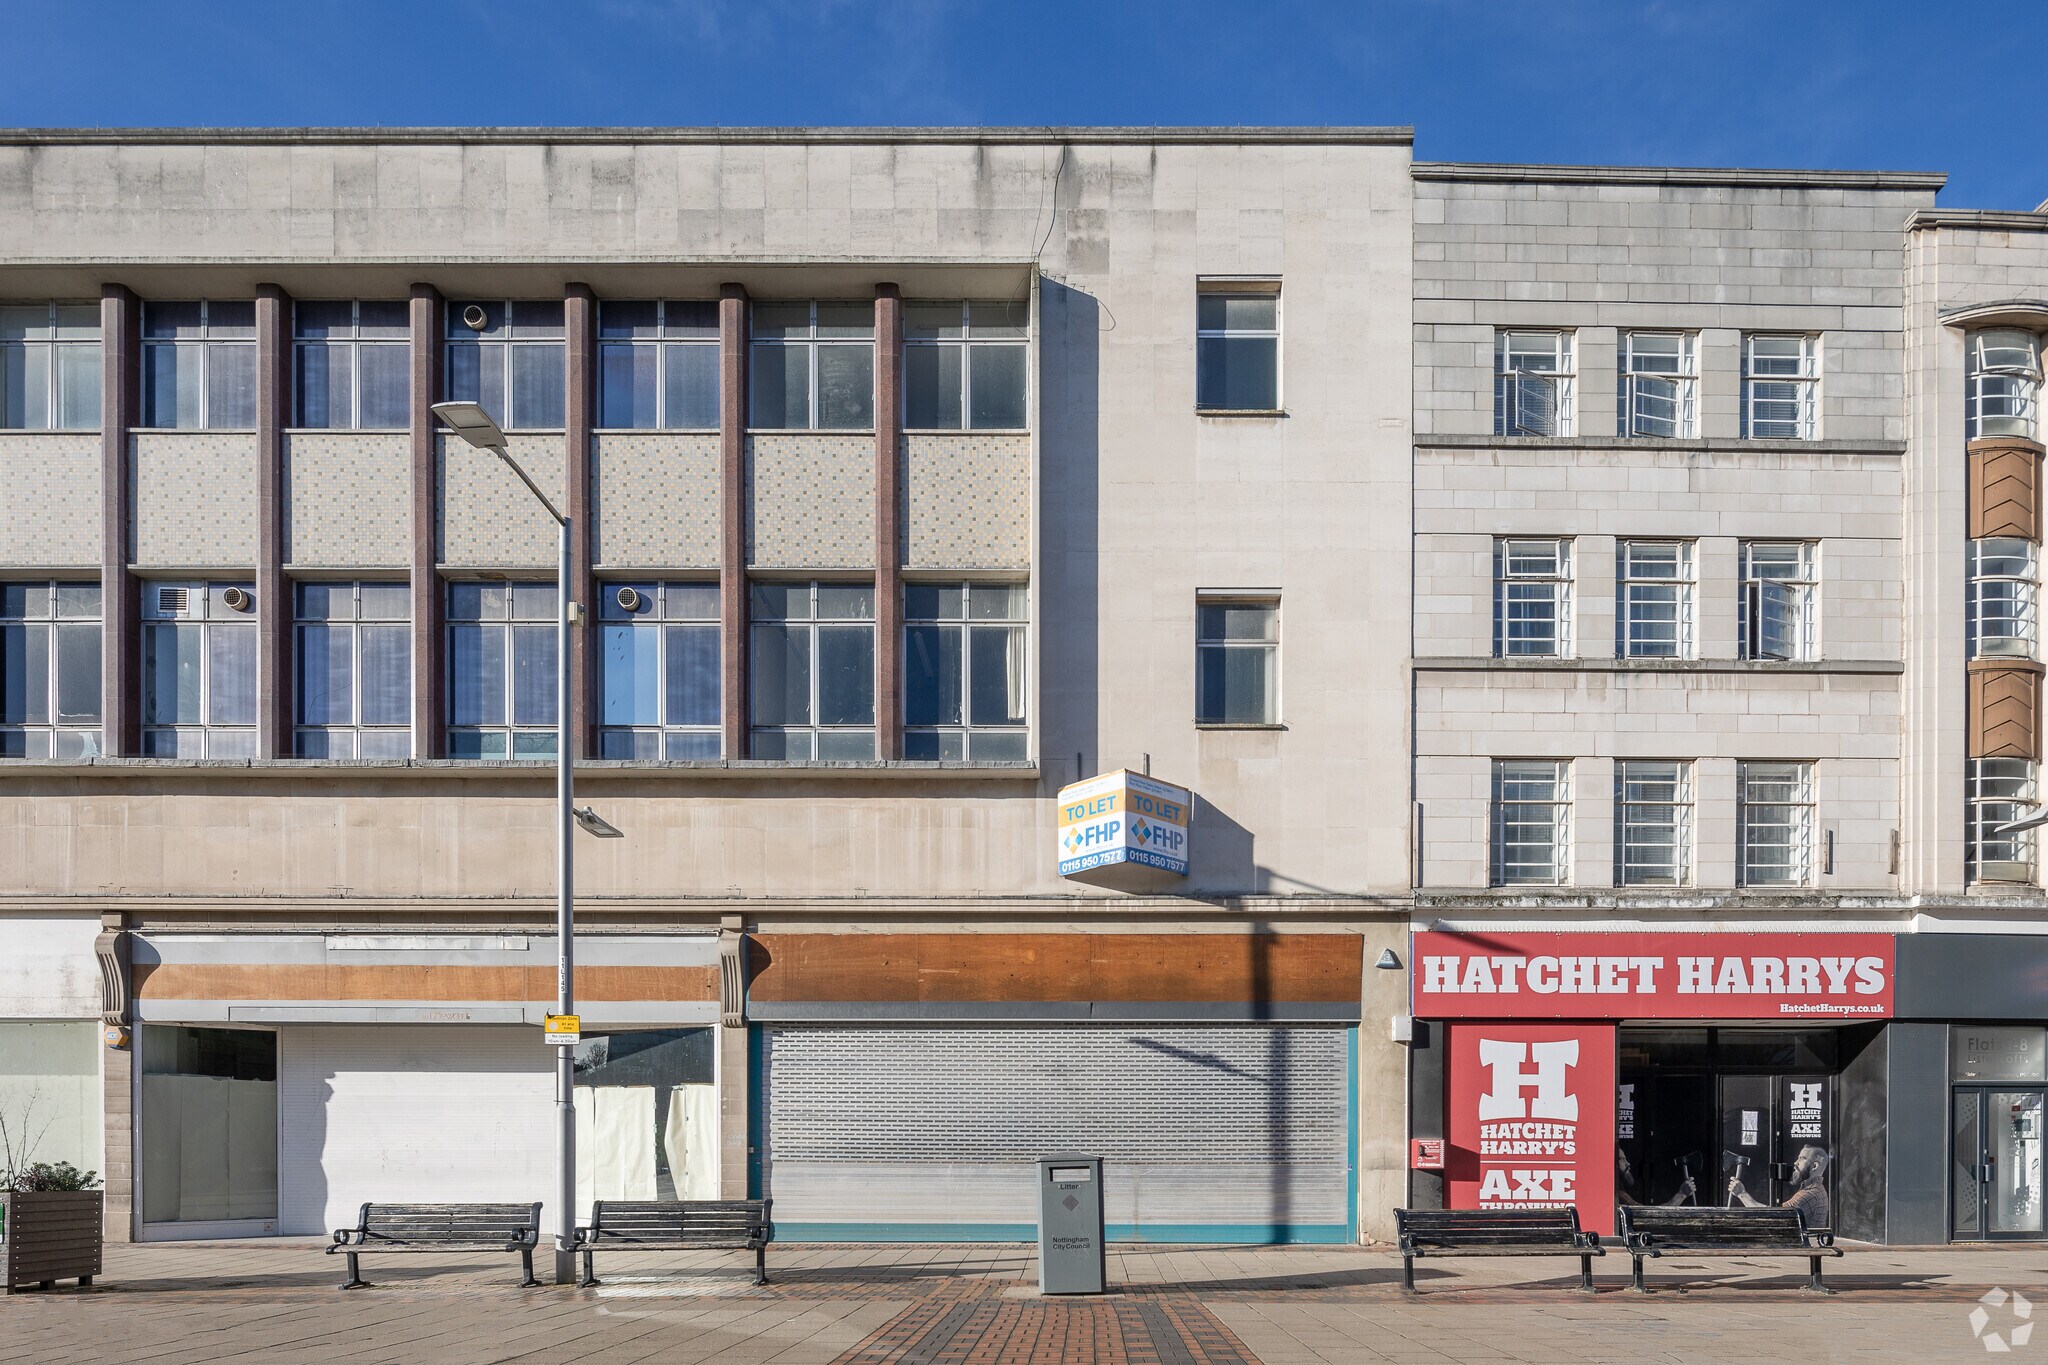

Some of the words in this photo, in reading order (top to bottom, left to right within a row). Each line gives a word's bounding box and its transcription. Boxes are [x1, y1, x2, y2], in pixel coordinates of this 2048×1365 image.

[1066, 805, 1085, 821] TO
[1088, 795, 1116, 816] LET
[1134, 795, 1153, 813] TO
[1155, 801, 1181, 821] LET
[1085, 820, 1121, 846] FHP
[1152, 825, 1184, 850] FHP
[1061, 859, 1081, 872] 0115
[1081, 855, 1099, 867] 950
[1099, 850, 1122, 864] 7577
[1129, 850, 1149, 863] 0115
[1150, 855, 1166, 867] 950
[1166, 858, 1185, 872] 7577
[1422, 956, 1663, 994] HATCHET
[1677, 956, 1885, 995] HARRYS
[1780, 1003, 1885, 1015] HatchetHarrys.co.uk
[1968, 1054, 1996, 1064] Liste
[1479, 1038, 1579, 1122] H
[1480, 1122, 1576, 1139] HATCHET
[1791, 1123, 1821, 1134] AXE
[1480, 1140, 1576, 1155] HARRY'S
[1479, 1169, 1576, 1200] AXE
[1052, 1236, 1090, 1244] Nottingham
[1052, 1243, 1065, 1251] City
